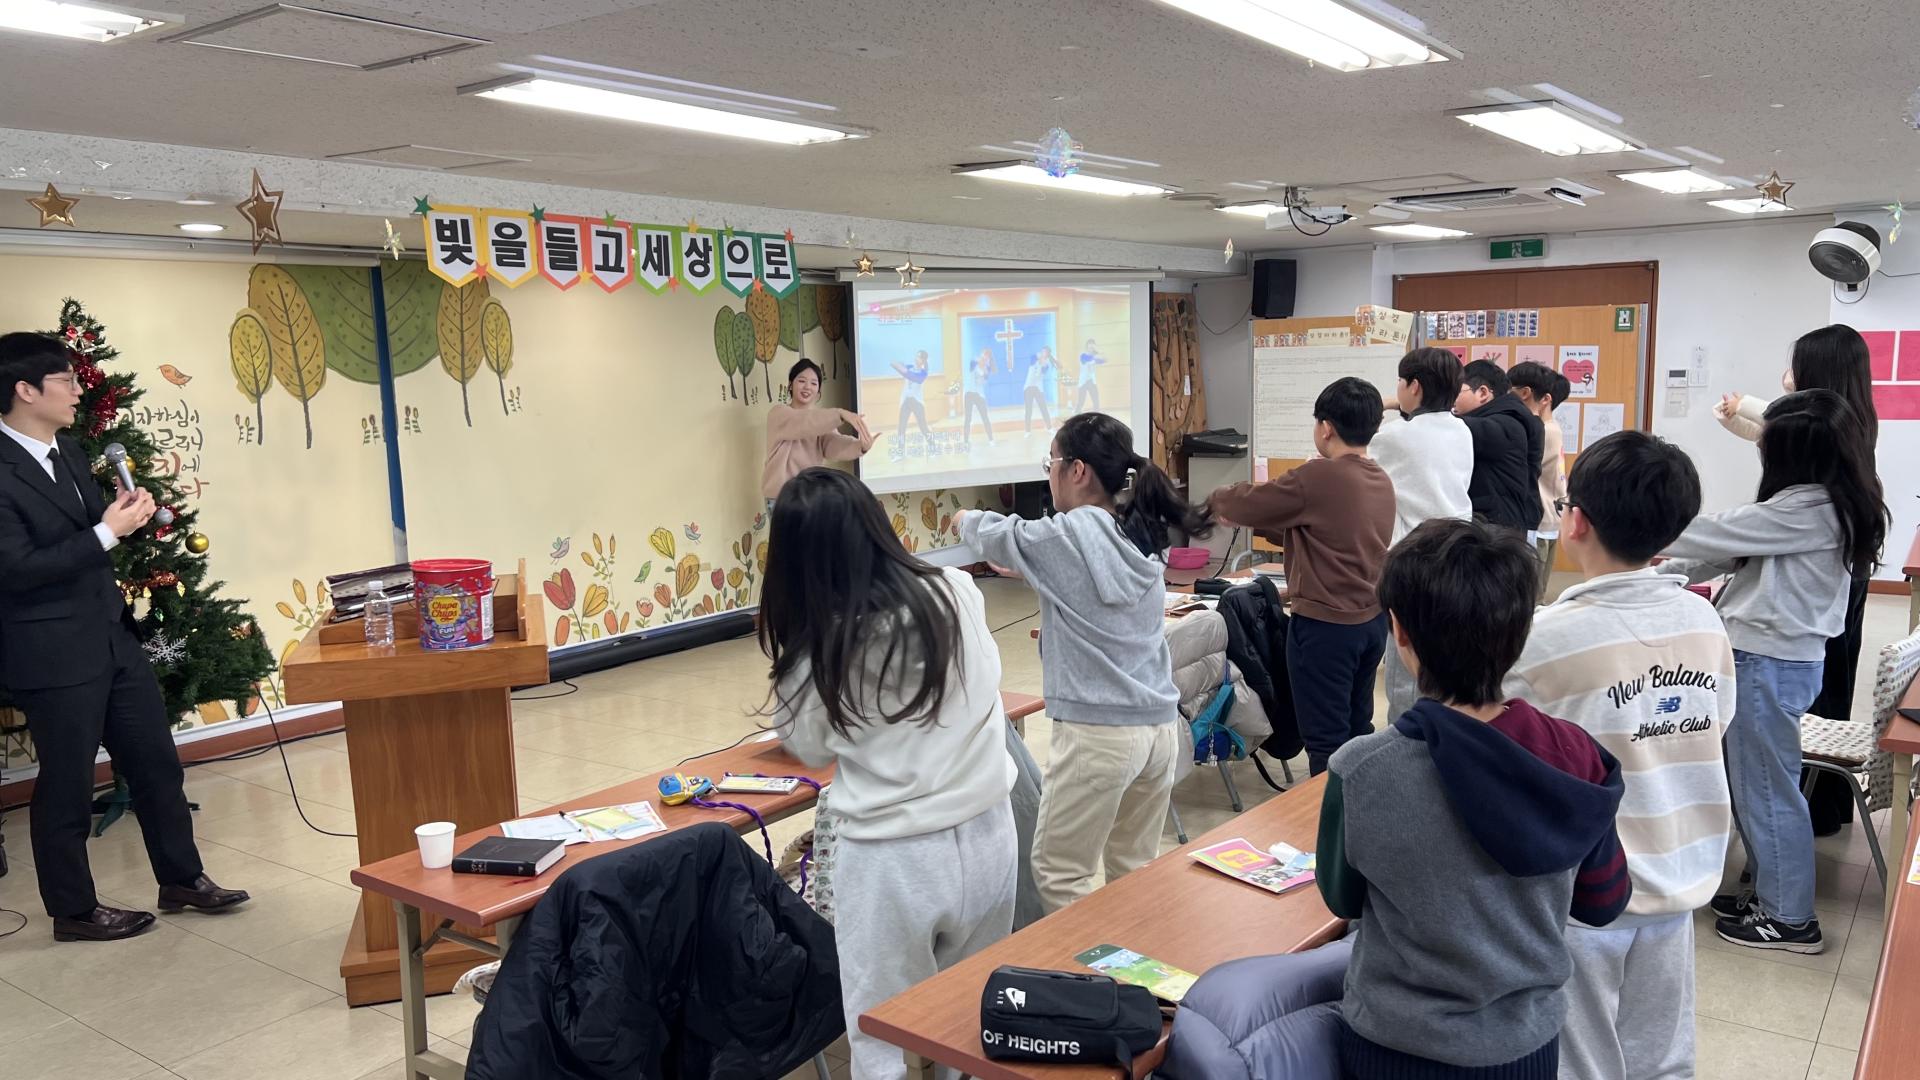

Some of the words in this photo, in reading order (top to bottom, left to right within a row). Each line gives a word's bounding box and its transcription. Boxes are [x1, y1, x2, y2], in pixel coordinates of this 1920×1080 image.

[1607, 673, 1645, 709] New
[1630, 719, 1677, 742] Athletic
[1679, 714, 1711, 734] Club
[1755, 923, 1782, 941] N
[983, 1029, 1004, 1045] OF
[1008, 1034, 1081, 1055] HEIGHTS
